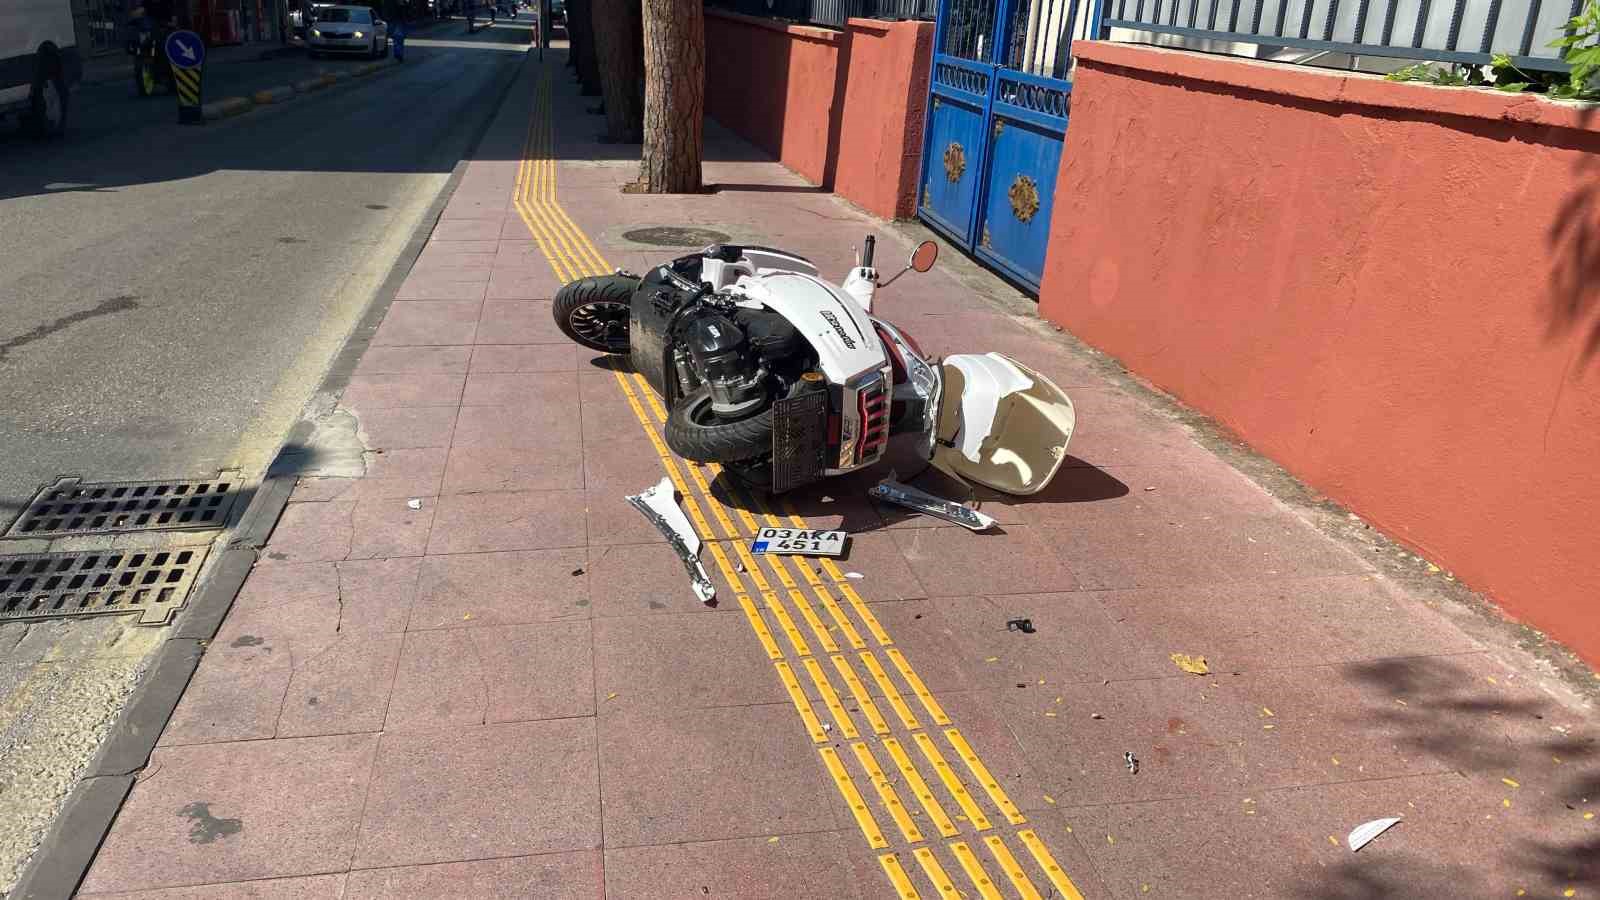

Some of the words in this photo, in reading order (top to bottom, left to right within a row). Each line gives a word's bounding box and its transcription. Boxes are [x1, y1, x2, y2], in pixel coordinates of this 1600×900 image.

[763, 529, 792, 539] 03
[796, 531, 839, 541] AKA
[777, 540, 820, 550] 451
